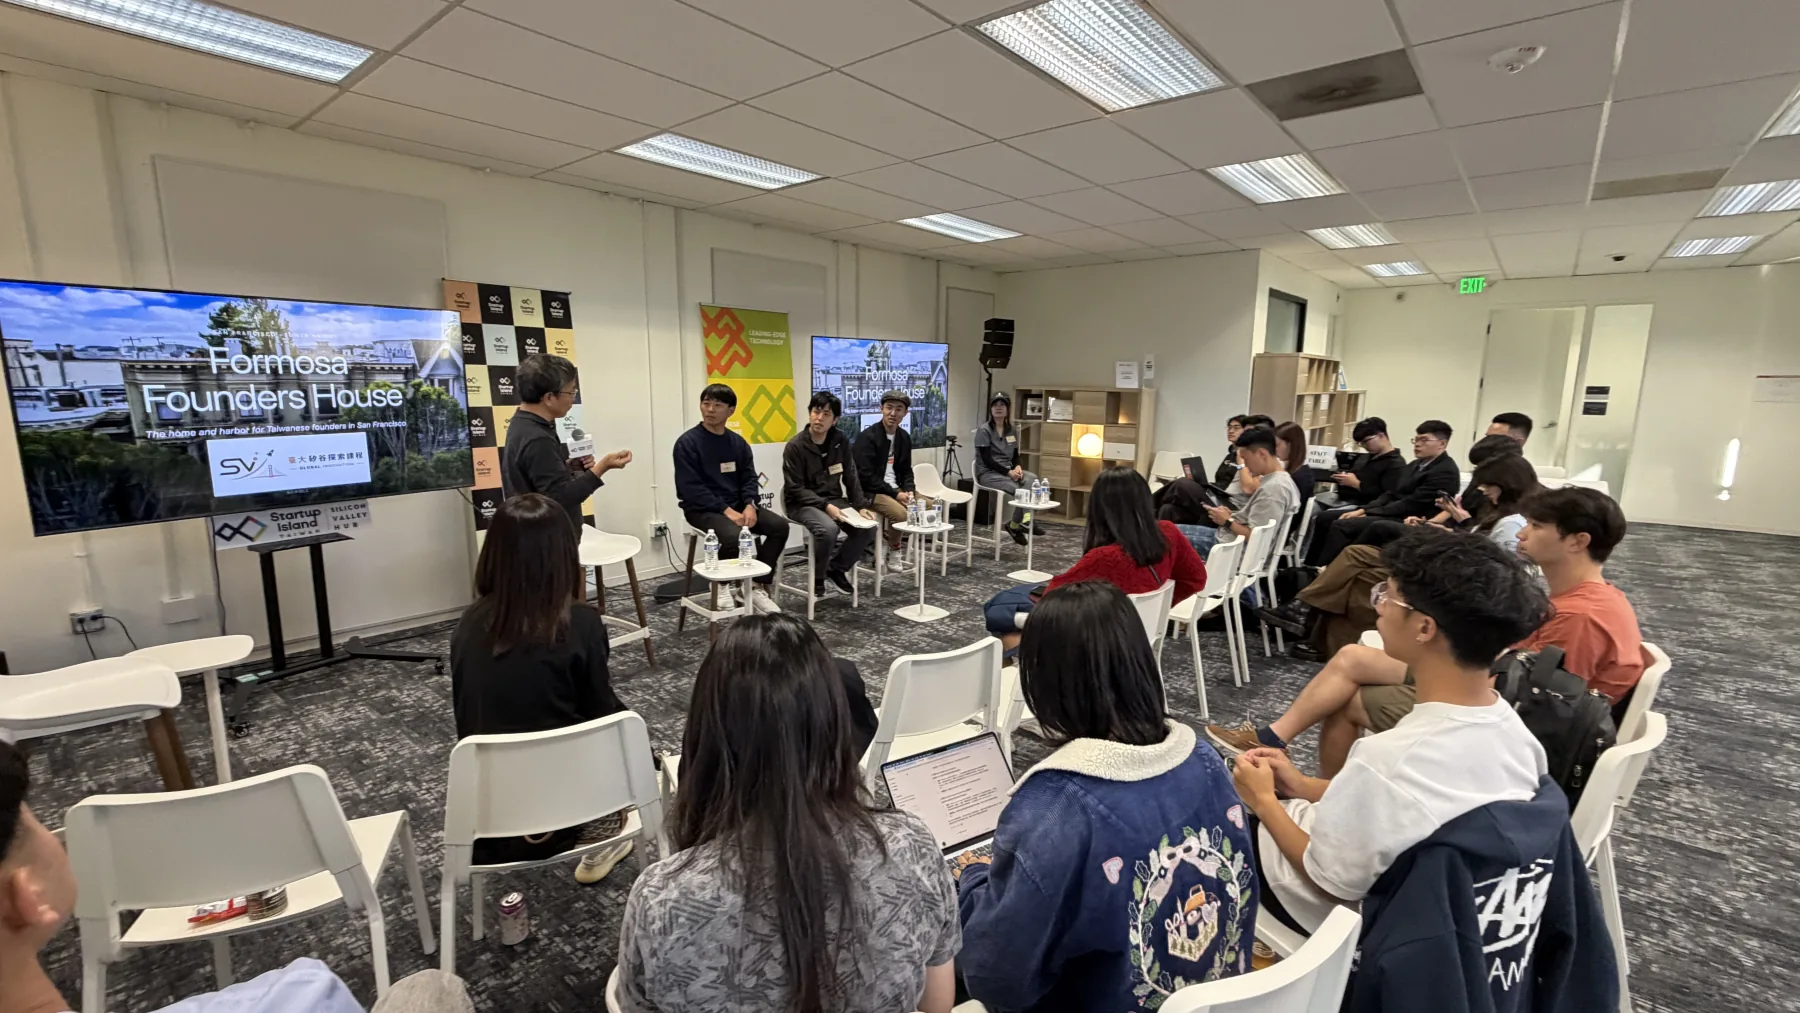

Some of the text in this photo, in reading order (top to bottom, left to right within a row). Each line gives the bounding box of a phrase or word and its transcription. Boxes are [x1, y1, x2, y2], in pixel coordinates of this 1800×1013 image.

[1460, 277, 1486, 294] EXIT
[749, 337, 784, 346] TECHNOLOGY
[209, 346, 349, 375] Formosa
[865, 366, 908, 381] Formosa
[142, 383, 403, 413] Founders House
[845, 386, 925, 401] Founde ouse
[145, 430, 167, 439] The
[168, 429, 196, 438] home
[198, 428, 217, 437] and
[219, 427, 250, 436] harbor
[251, 426, 264, 434] for
[266, 425, 310, 433] Taiwanese
[312, 423, 347, 431] founders
[357, 421, 371, 429] San
[372, 420, 407, 428] Francisco
[330, 502, 367, 513] SILICON
[270, 508, 322, 523] Startup
[332, 511, 368, 522] VALLEY
[277, 517, 319, 533] Island
[334, 521, 359, 531] HUB
